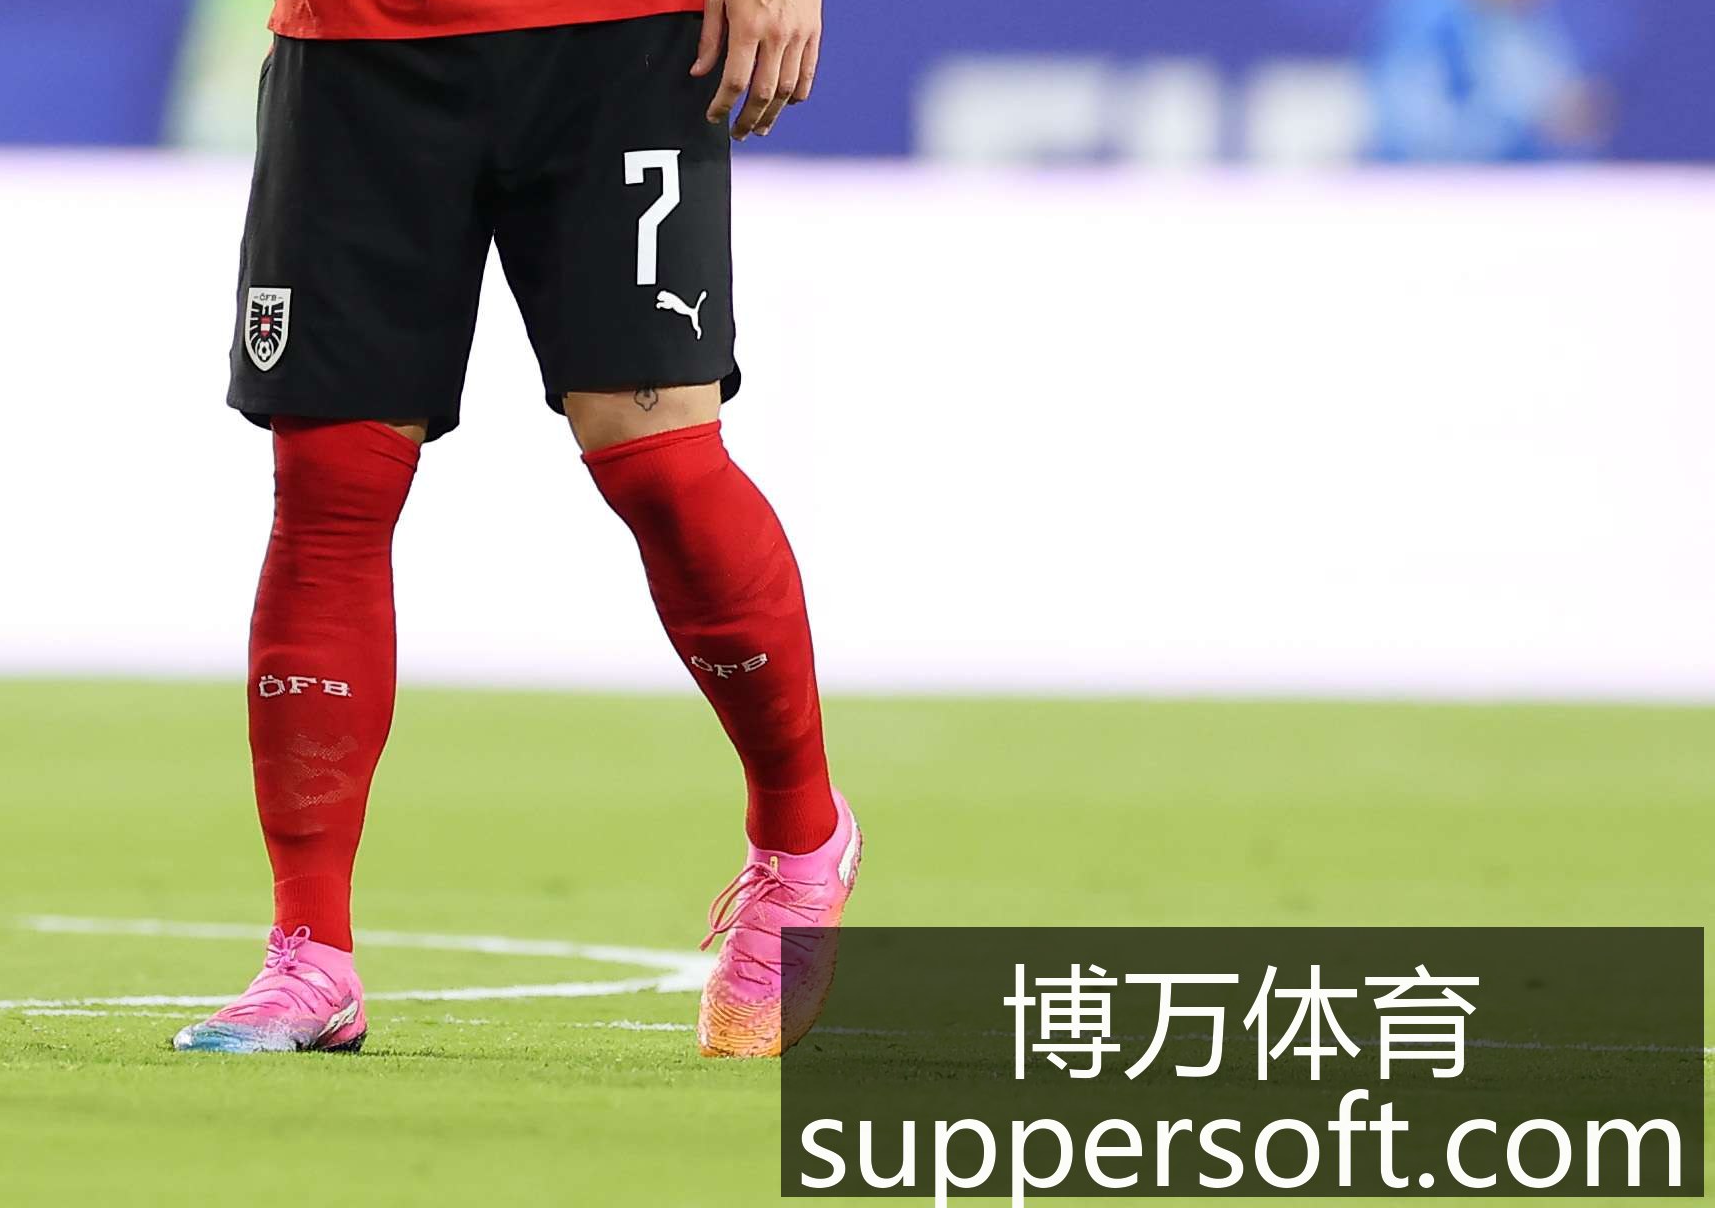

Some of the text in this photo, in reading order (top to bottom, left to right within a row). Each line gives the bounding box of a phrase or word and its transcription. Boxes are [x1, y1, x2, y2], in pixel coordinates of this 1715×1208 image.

[624, 149, 681, 285] 7
[690, 653, 768, 679] ÖFB
[258, 674, 352, 698] ÖFB
